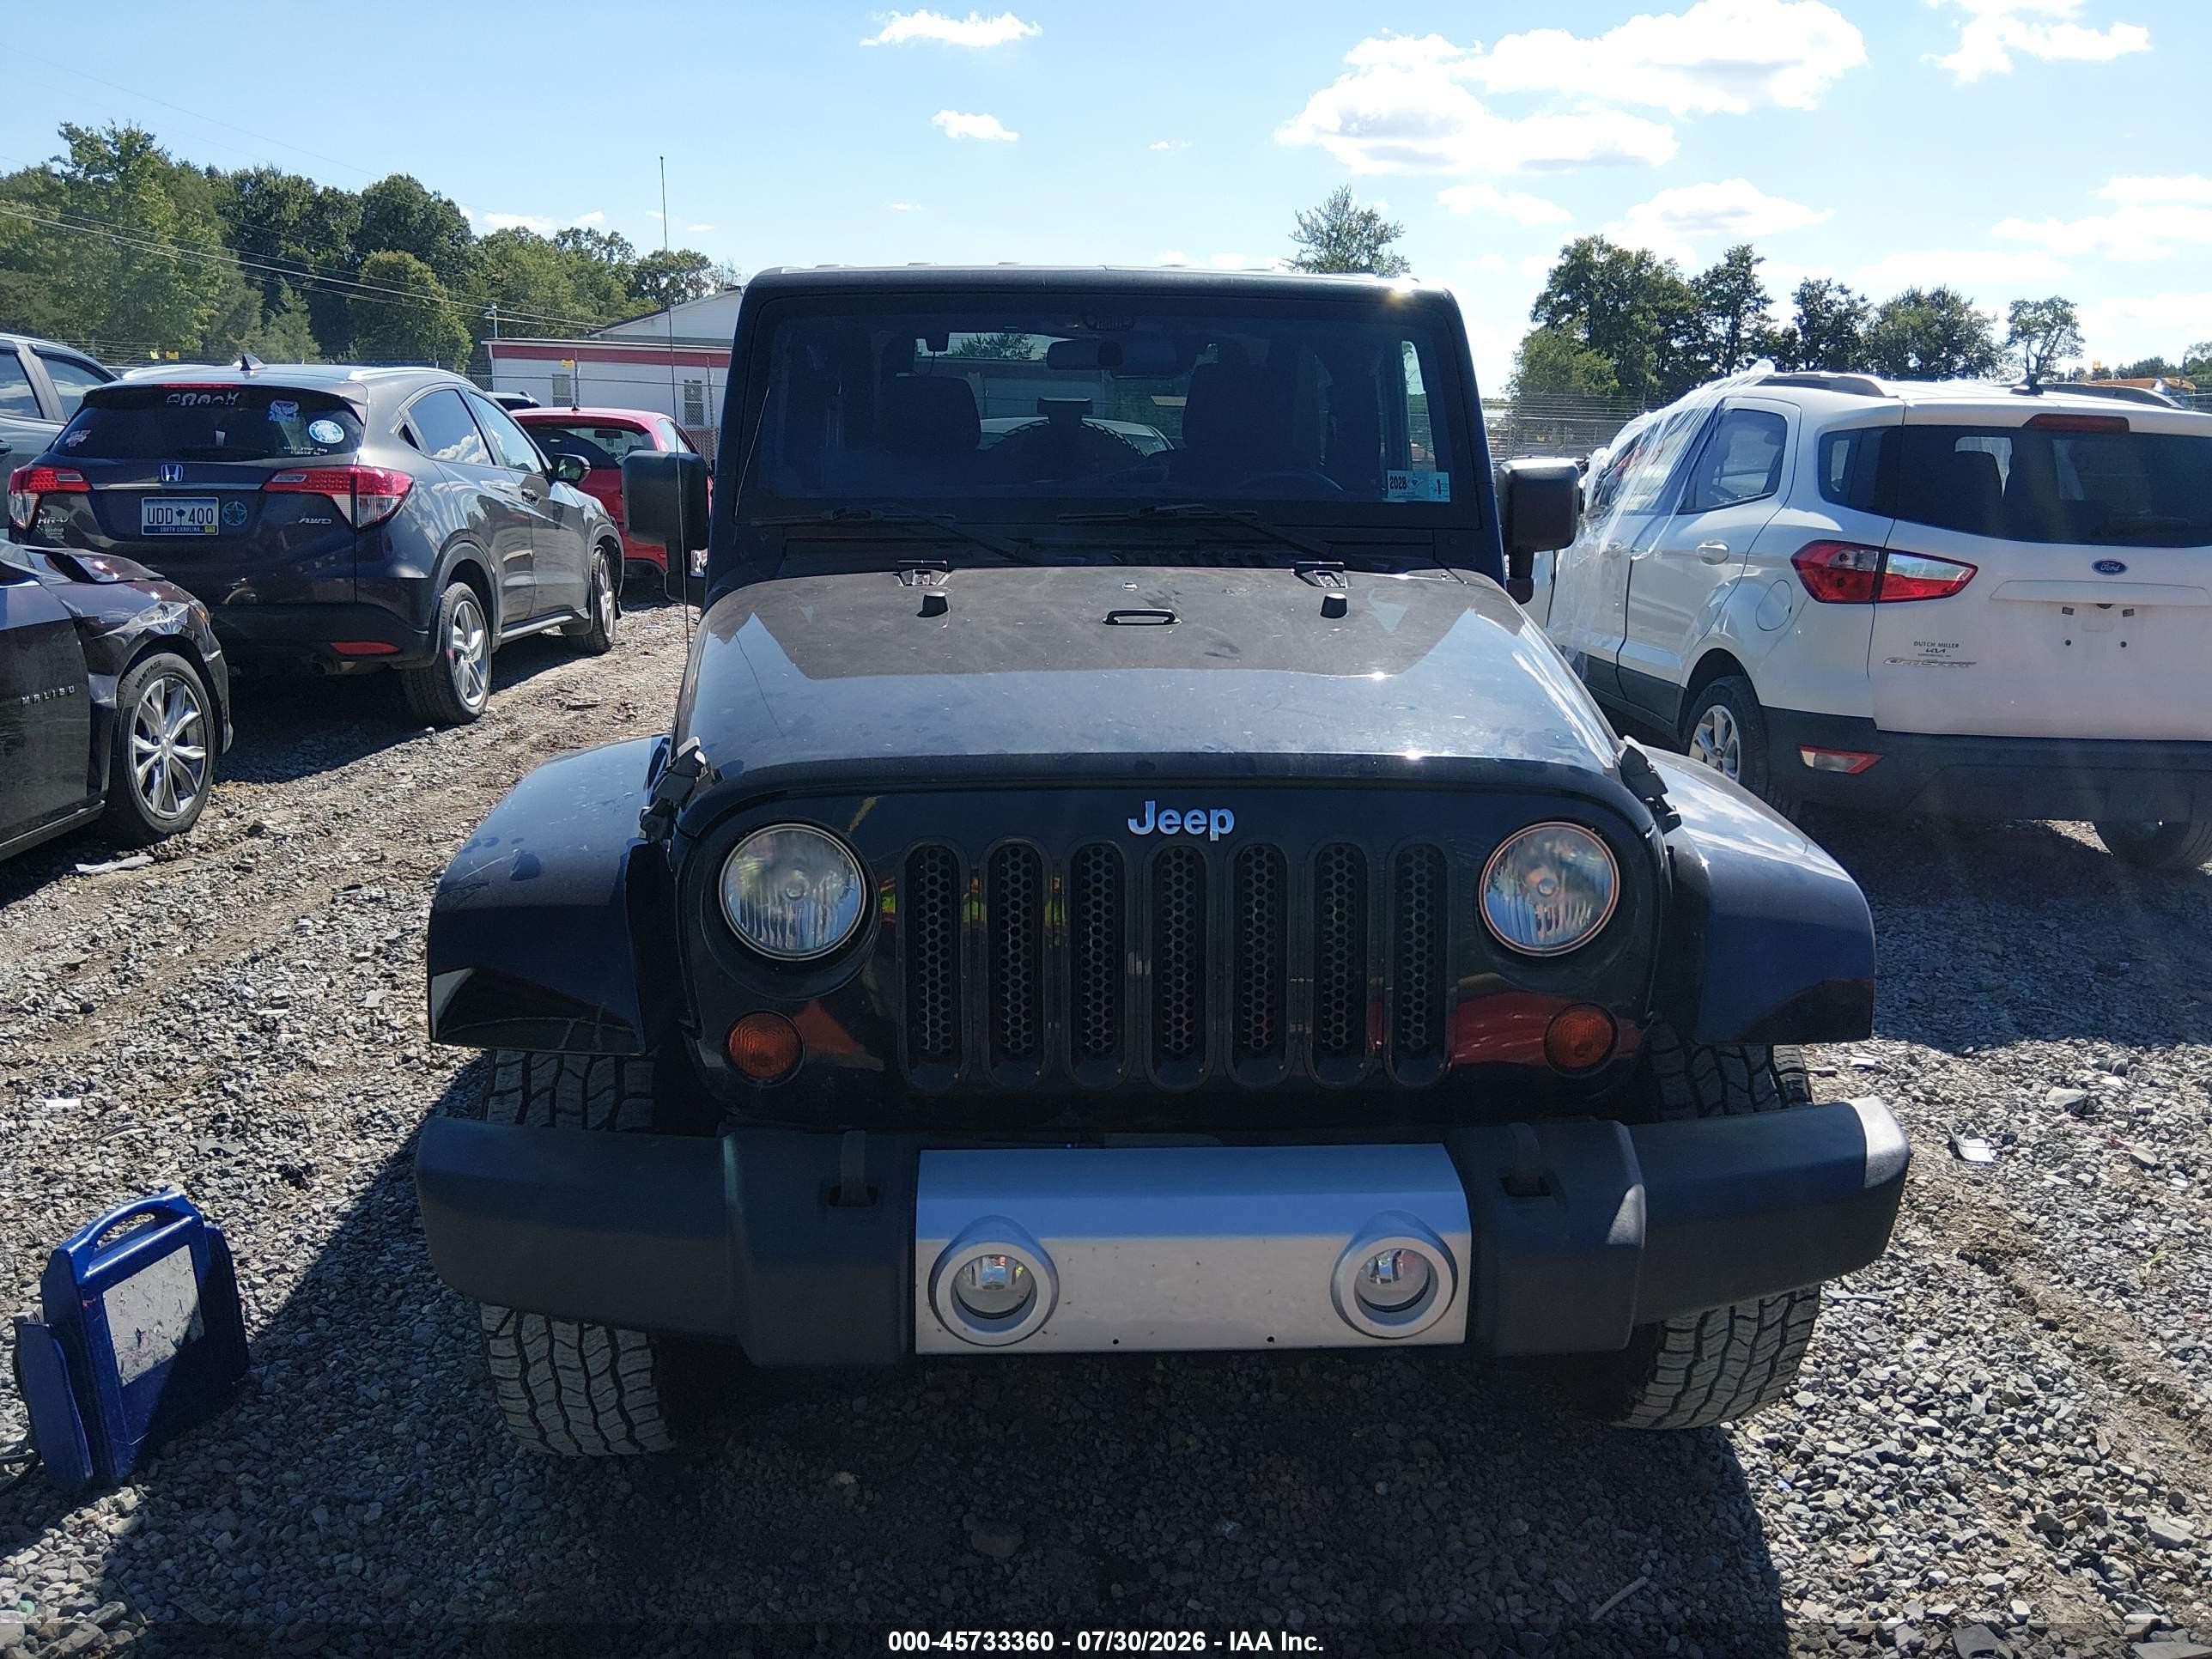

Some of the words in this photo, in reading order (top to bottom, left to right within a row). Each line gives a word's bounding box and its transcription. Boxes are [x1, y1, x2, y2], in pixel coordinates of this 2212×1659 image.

[1389, 476, 1407, 489] 2028
[37, 516, 70, 525] HR-V
[147, 507, 173, 525] UDD
[187, 507, 214, 525] 400
[21, 685, 76, 706] MALIBU
[1127, 799, 1235, 842] Jeep
